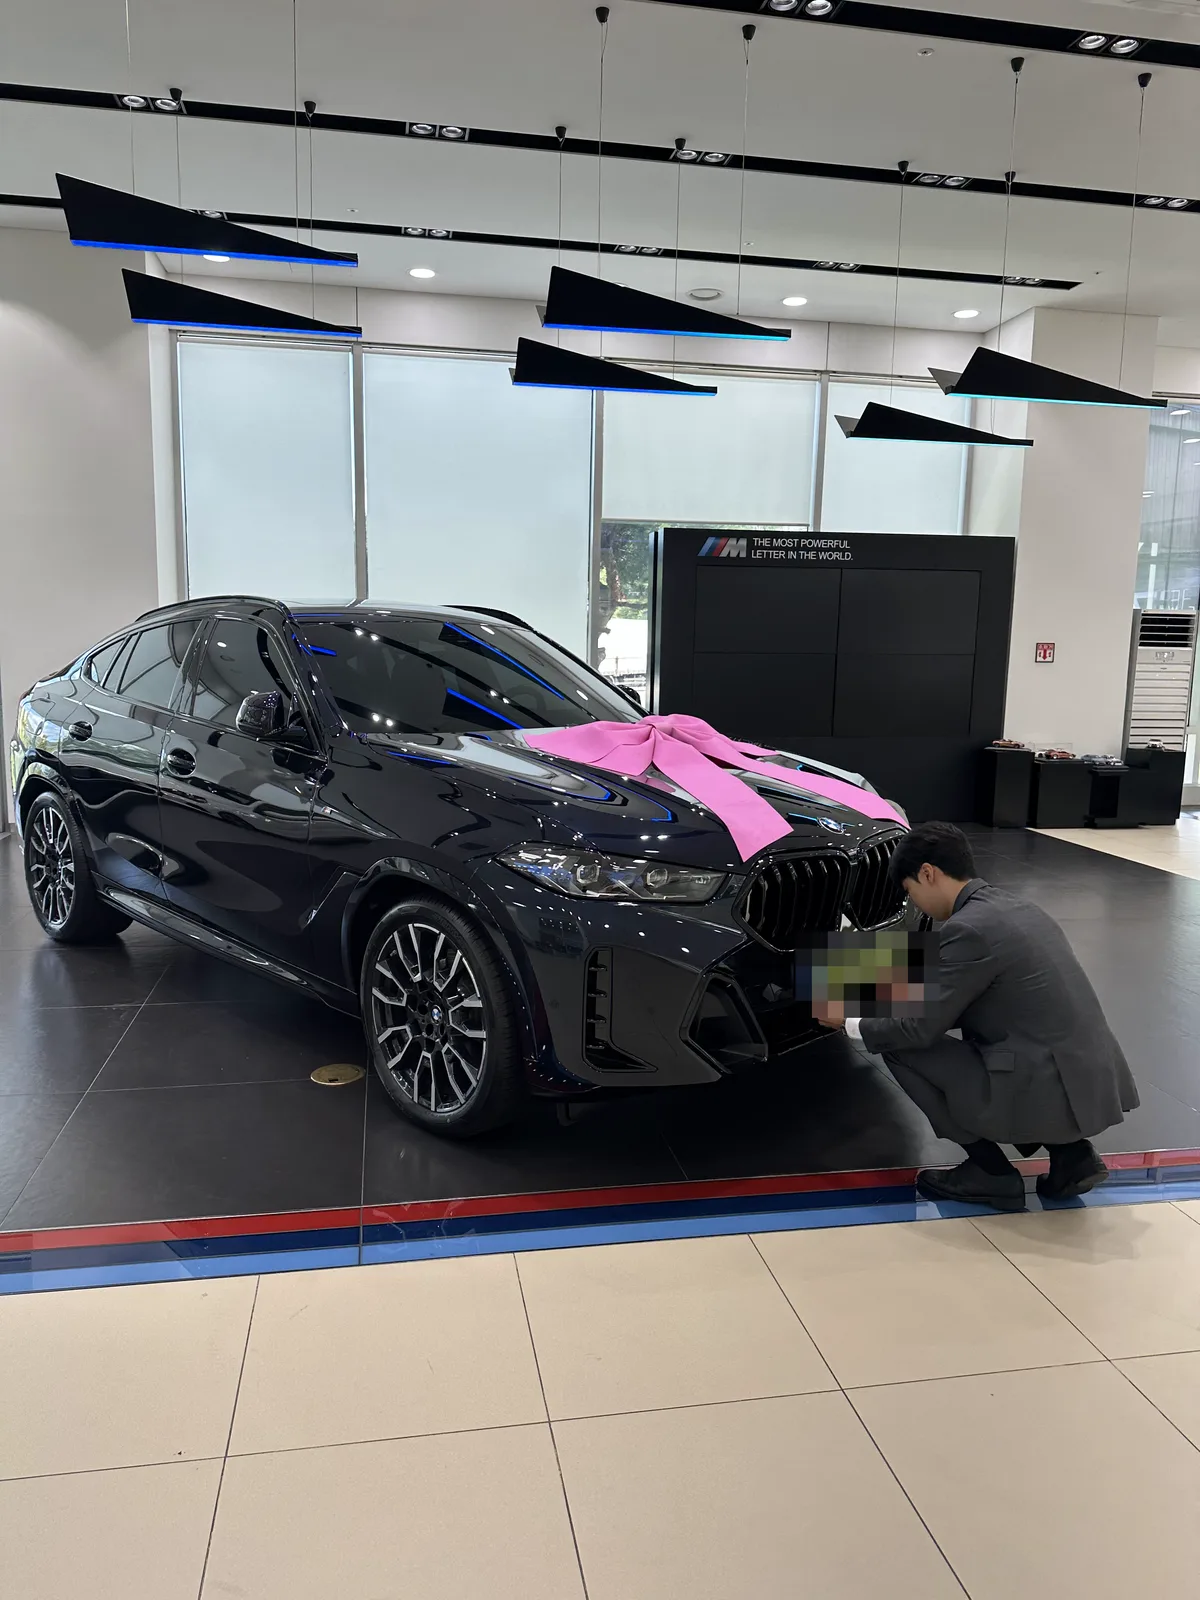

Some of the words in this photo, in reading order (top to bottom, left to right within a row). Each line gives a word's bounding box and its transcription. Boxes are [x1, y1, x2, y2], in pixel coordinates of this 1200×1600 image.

[718, 537, 748, 558] M
[752, 537, 771, 547] THE
[772, 538, 799, 548] MOST
[800, 538, 851, 549] POWERFUL
[751, 550, 786, 560] LETTER
[787, 550, 797, 560] IN
[798, 550, 817, 560] THE
[818, 551, 854, 561] WORLD.
